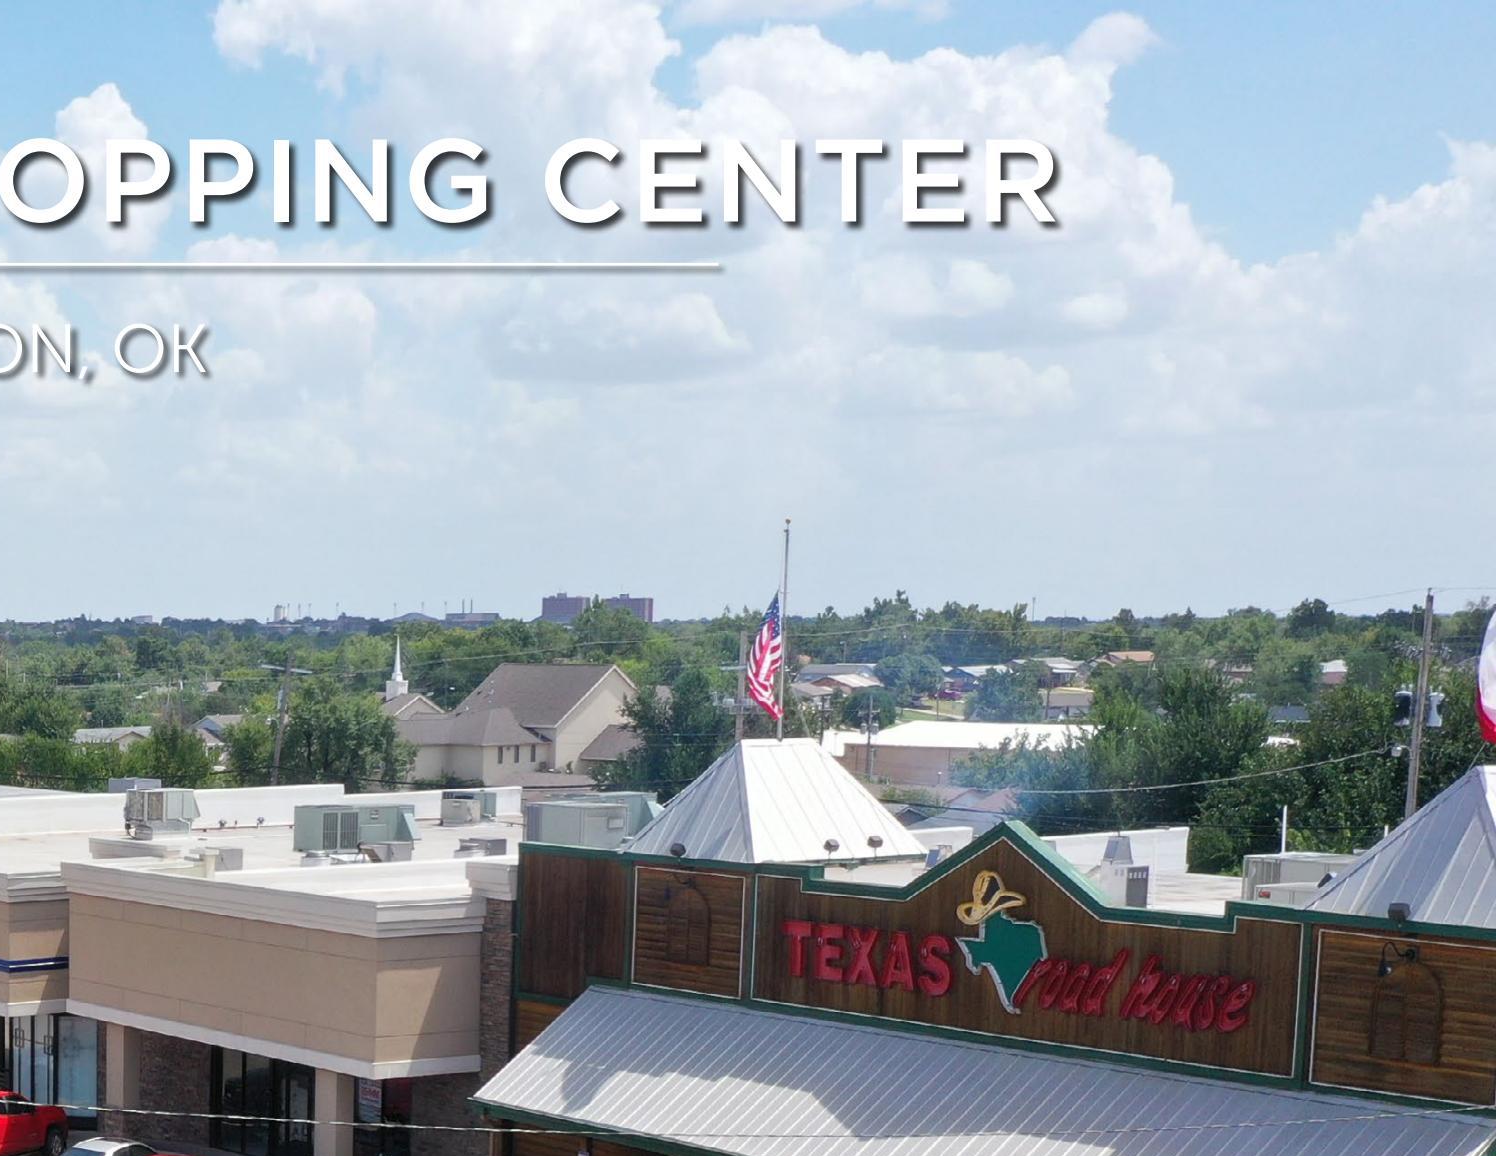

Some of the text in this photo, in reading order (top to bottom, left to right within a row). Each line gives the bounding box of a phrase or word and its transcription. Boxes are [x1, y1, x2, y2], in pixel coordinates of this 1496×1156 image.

[782, 920, 1258, 1033] TEXAS road house
